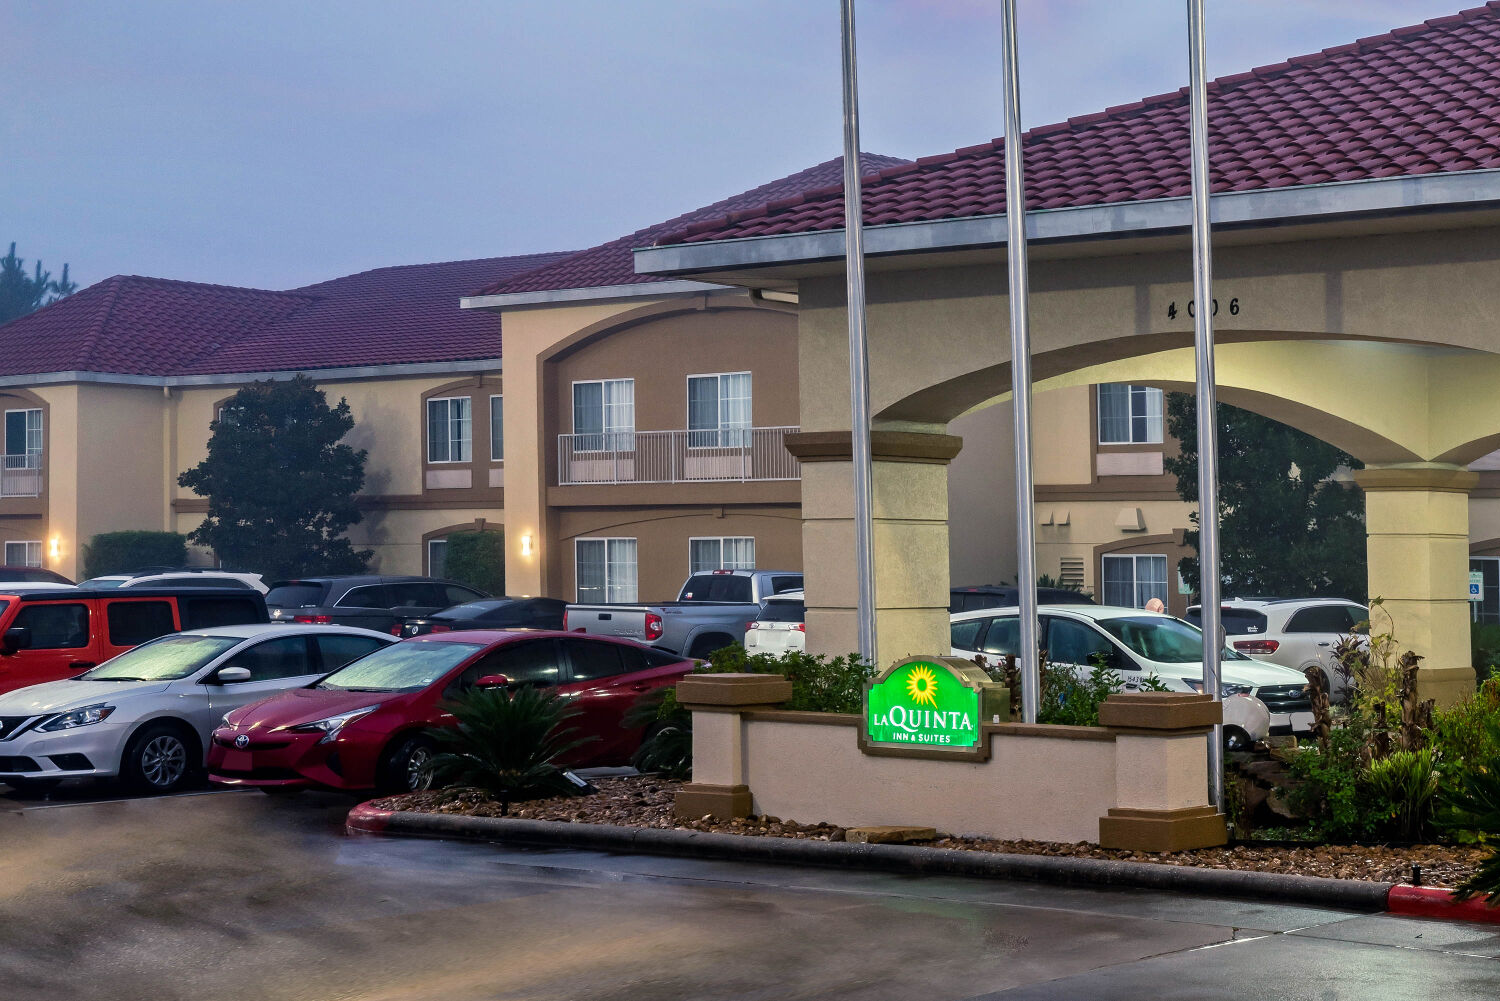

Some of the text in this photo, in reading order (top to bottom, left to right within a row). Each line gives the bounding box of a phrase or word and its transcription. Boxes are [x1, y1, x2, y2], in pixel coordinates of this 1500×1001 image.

[873, 705, 973, 732] LA QUINTA
[893, 732, 951, 743] INN & SUITES
